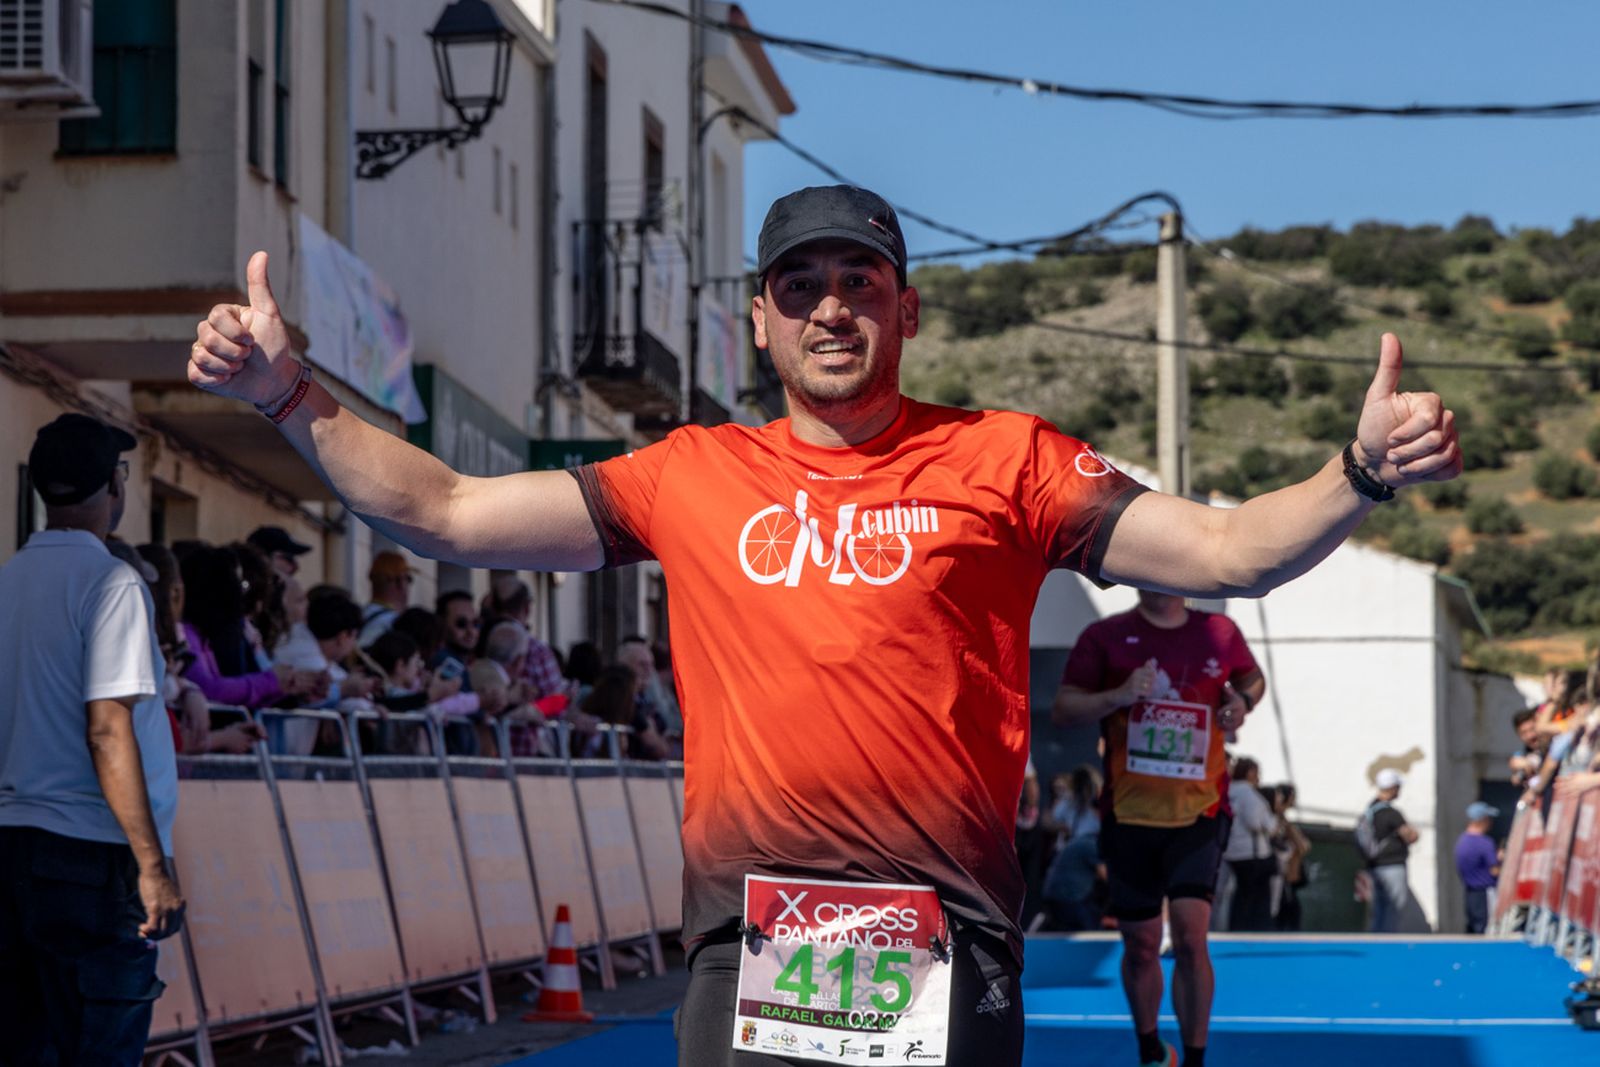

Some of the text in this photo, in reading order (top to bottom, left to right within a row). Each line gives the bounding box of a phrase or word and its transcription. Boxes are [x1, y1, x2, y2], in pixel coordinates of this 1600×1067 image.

[1144, 726, 1193, 754] 131
[776, 889, 808, 923] X
[814, 902, 918, 932] CROSS
[774, 924, 892, 952] PANTANO
[775, 944, 912, 1012] 415
[761, 1004, 819, 1024] RAFAEL
